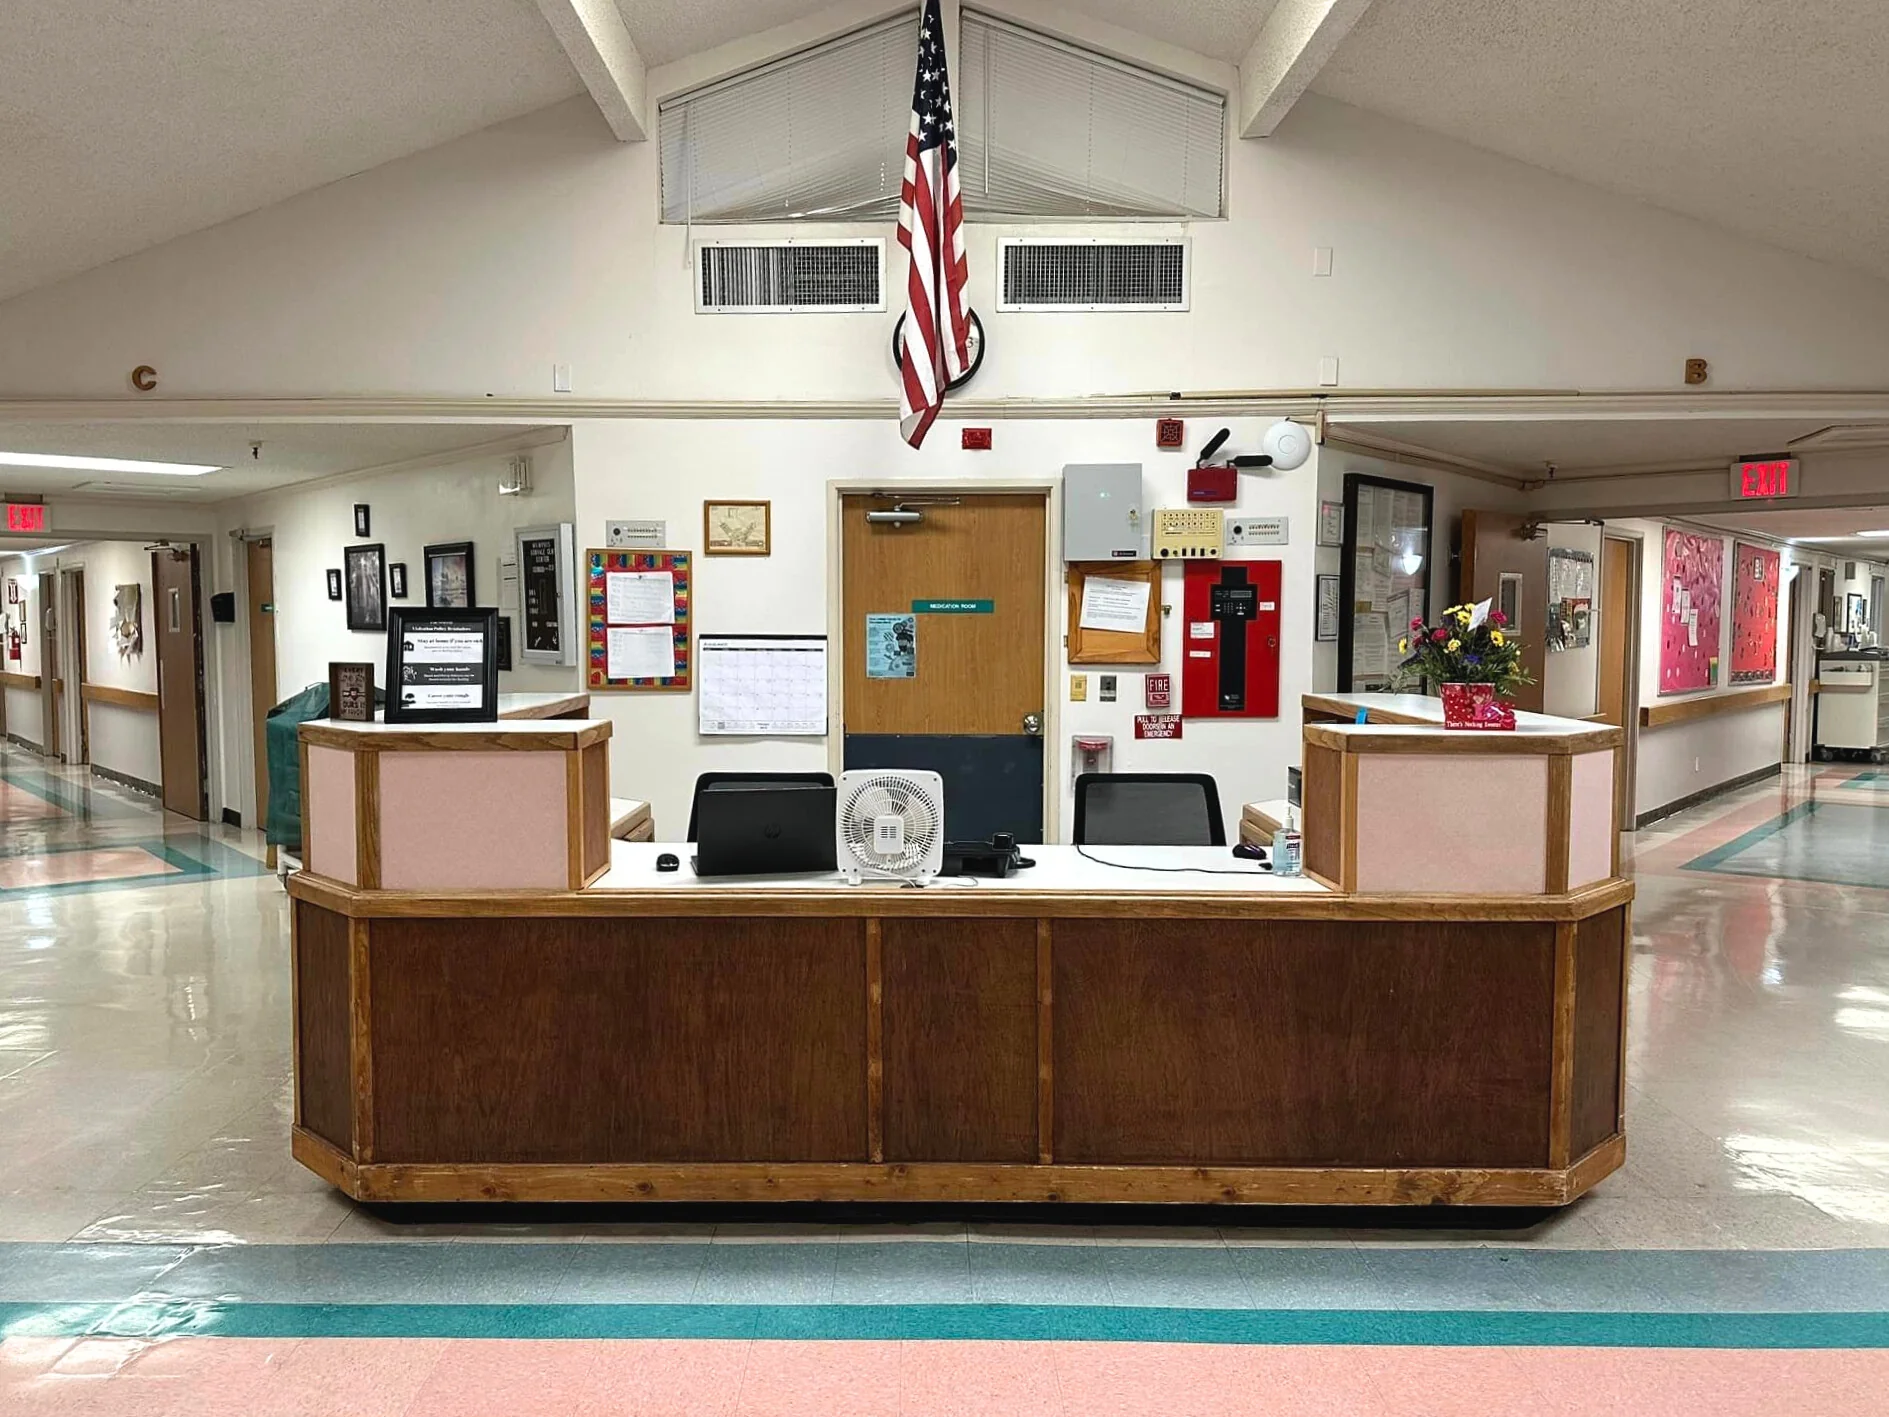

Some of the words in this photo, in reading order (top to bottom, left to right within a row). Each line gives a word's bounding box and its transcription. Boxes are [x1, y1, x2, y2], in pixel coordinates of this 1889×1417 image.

[132, 365, 157, 391] C
[1685, 359, 1708, 385] B
[1741, 461, 1790, 497] EXIT
[8, 505, 45, 531] EXIT
[1150, 680, 1168, 691] FIRE
